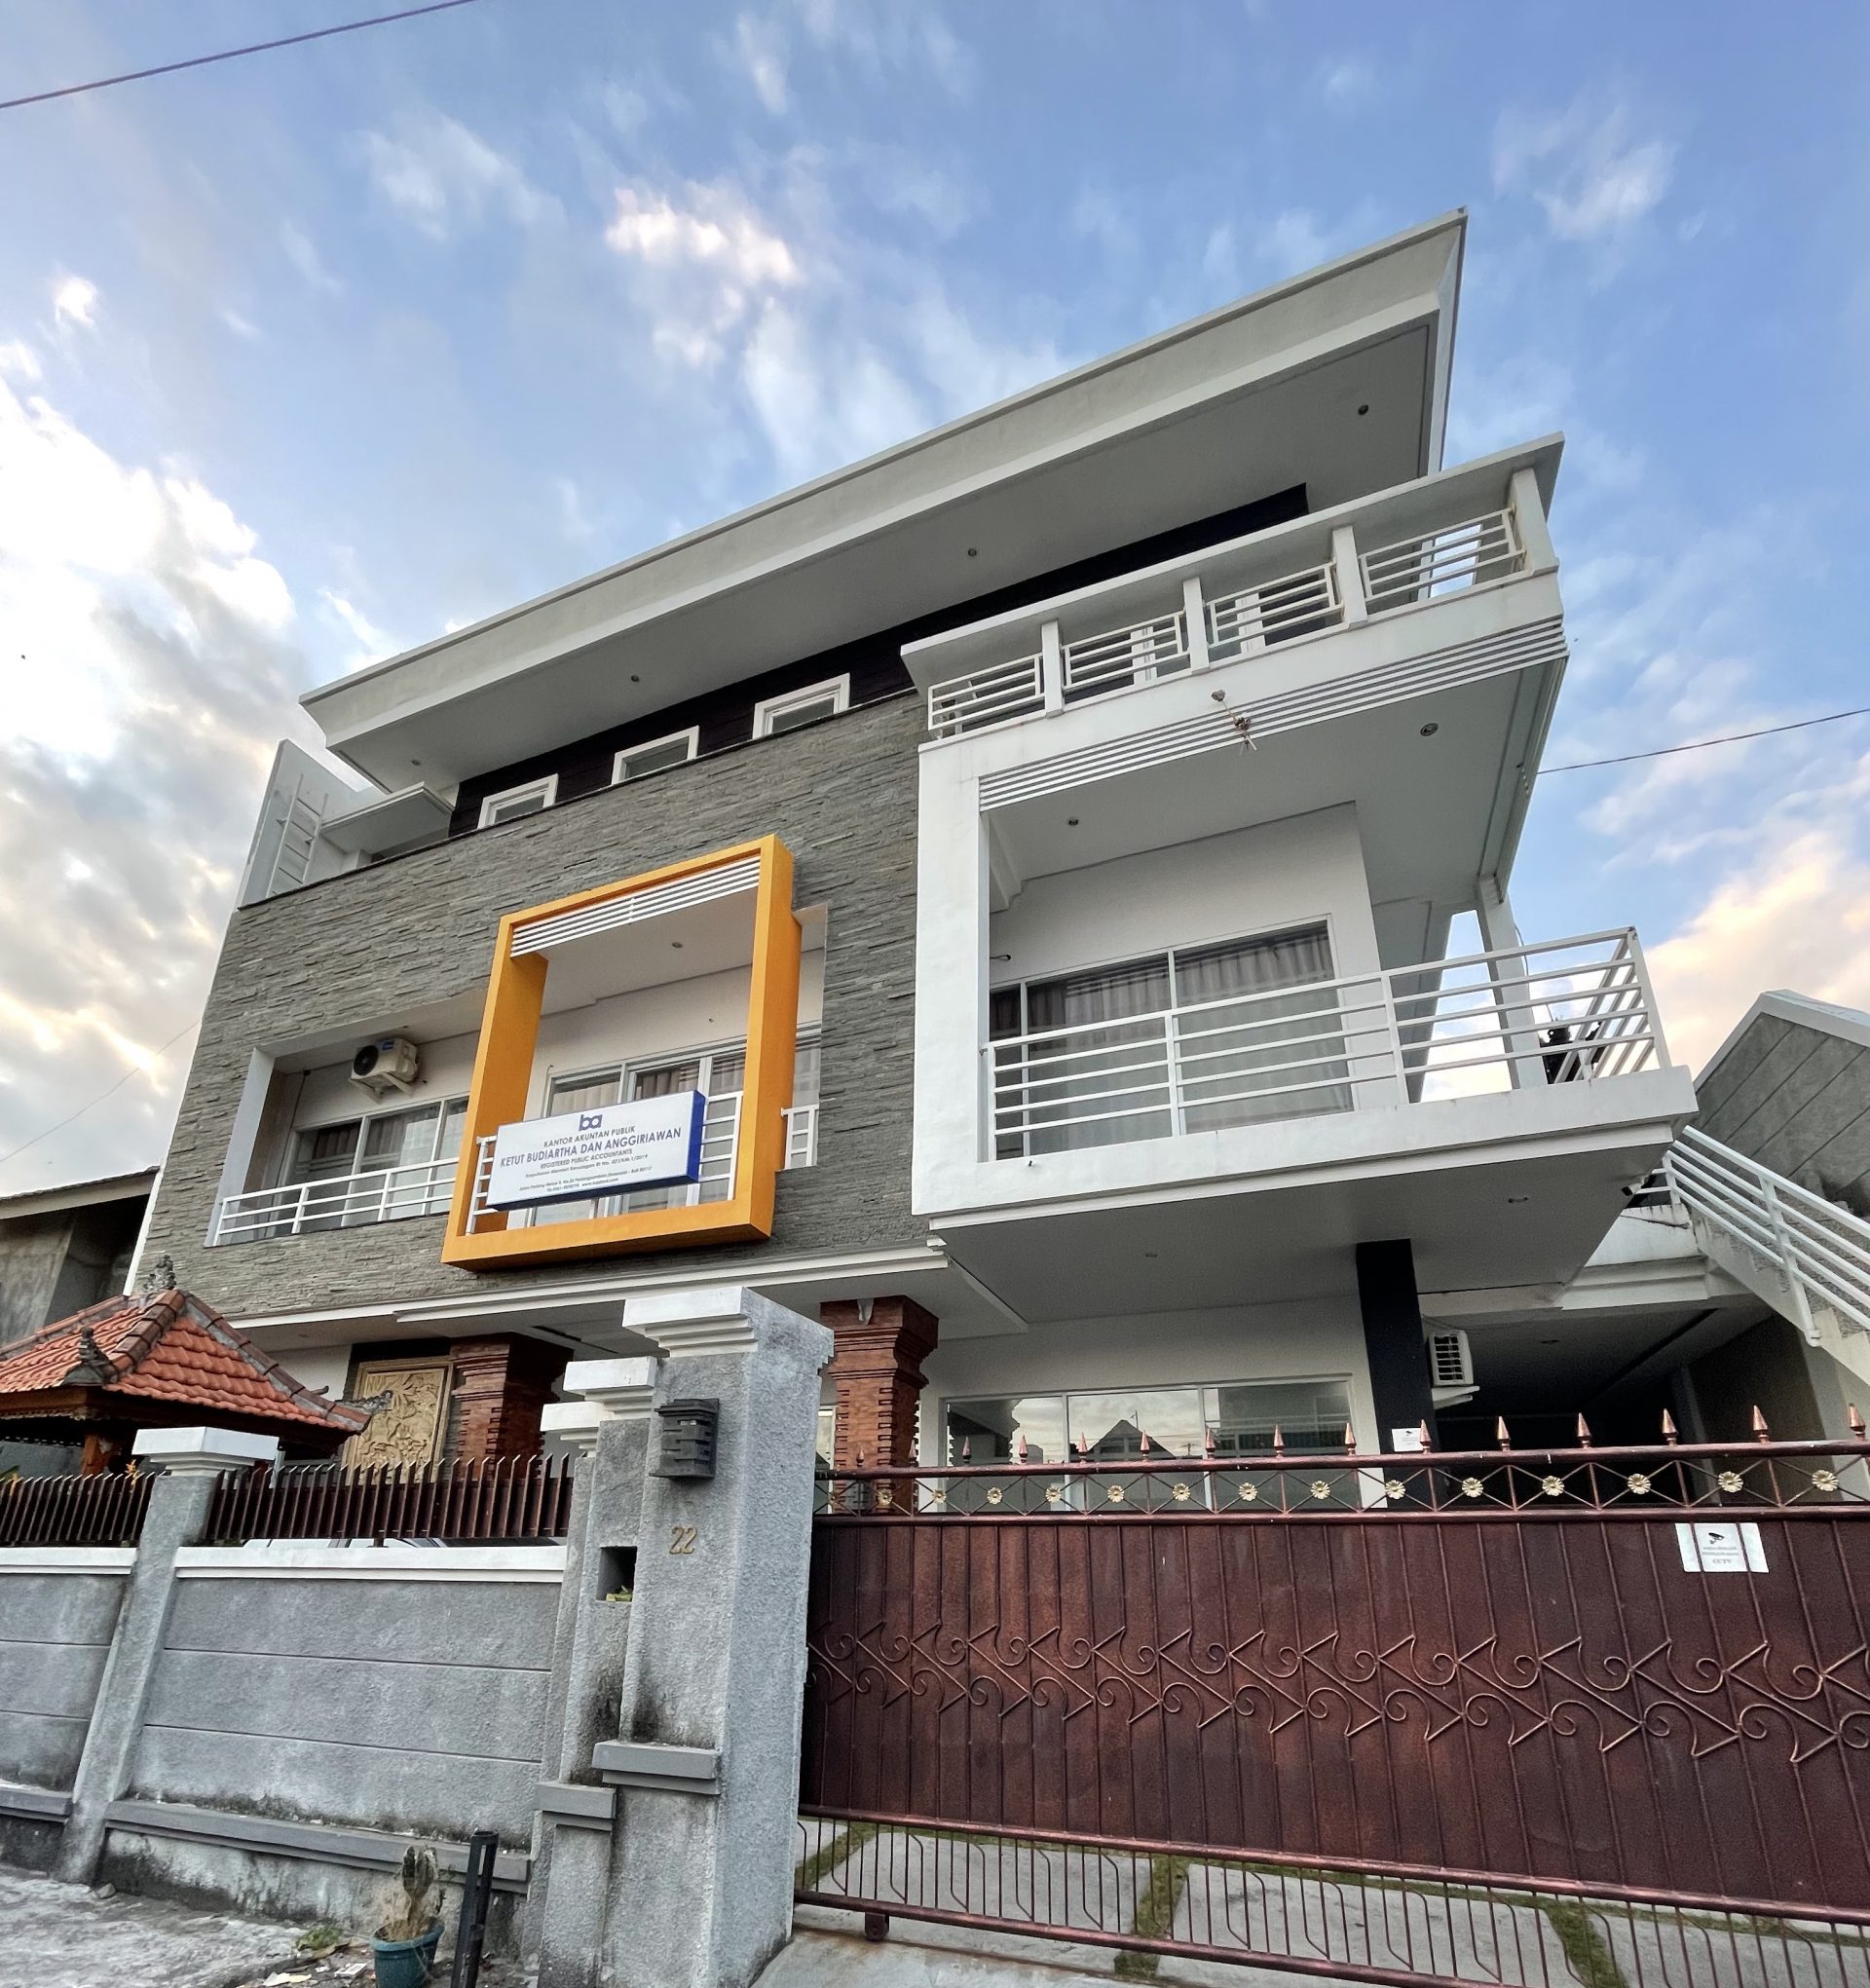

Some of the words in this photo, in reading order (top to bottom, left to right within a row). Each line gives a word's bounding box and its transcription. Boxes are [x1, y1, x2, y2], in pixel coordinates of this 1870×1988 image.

[500, 1154, 525, 1168] KETUT
[526, 1145, 578, 1163] BUDIARTHA
[580, 1142, 603, 1153] DAN
[604, 1128, 681, 1149] ANGGIRIAWAN
[543, 1137, 573, 1147] KANTOR
[574, 1131, 609, 1143] AKUNTAN
[611, 1126, 635, 1137] PUBLIK
[540, 1159, 570, 1169] REGISTERED
[571, 1156, 589, 1165] PUBLIC
[590, 1149, 632, 1160] ACCOUNTANTS
[669, 1527, 698, 1555] 22
